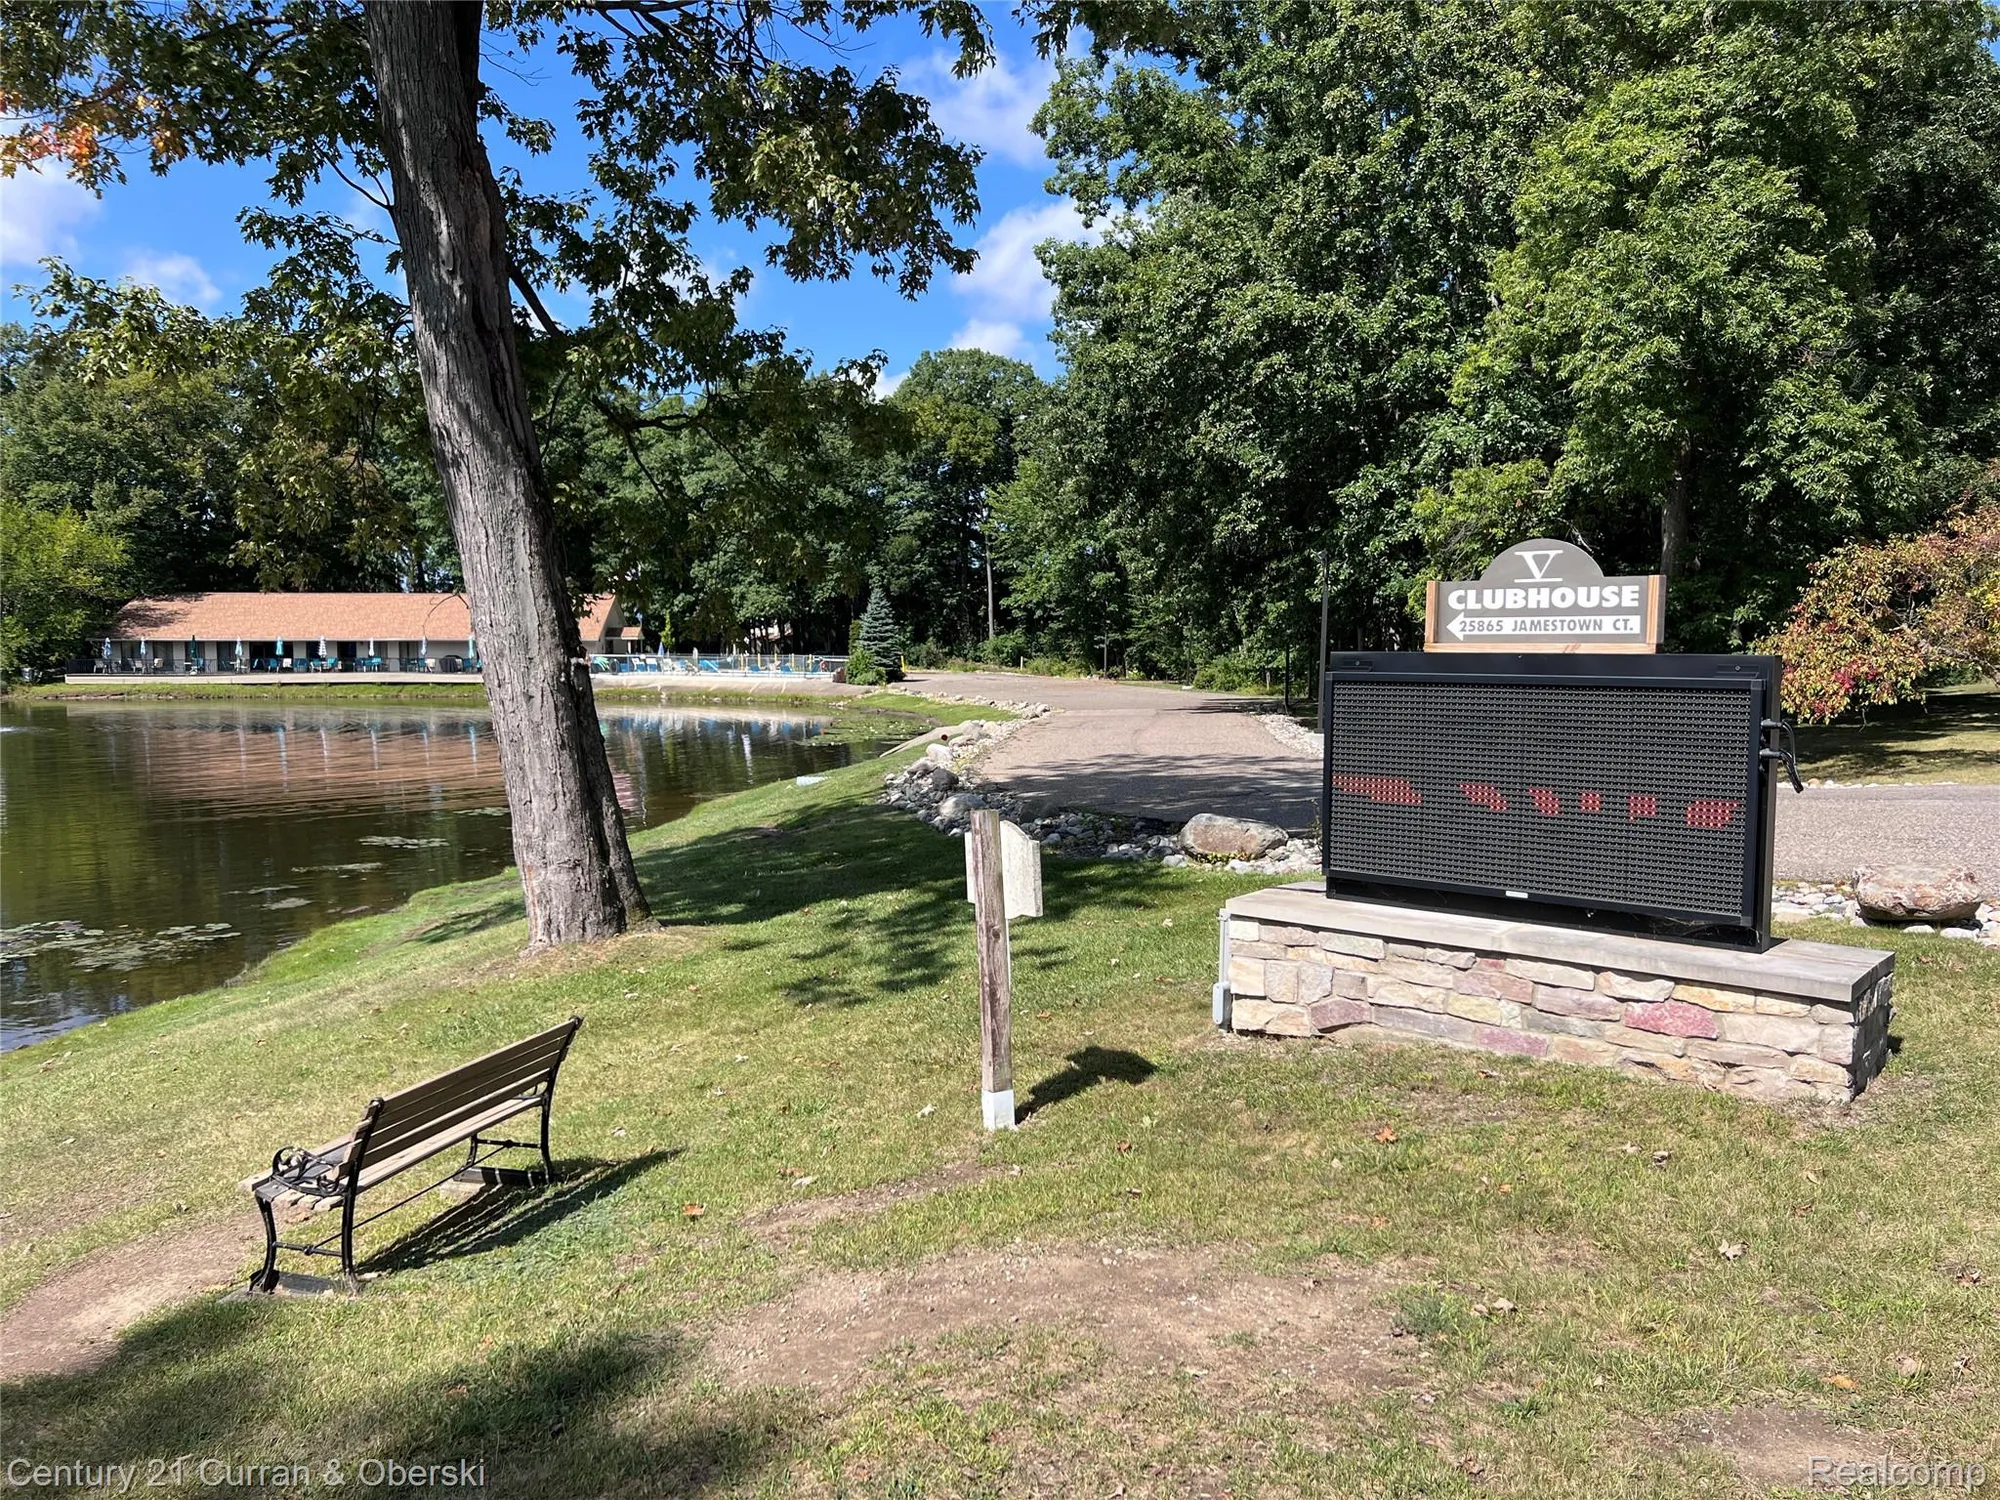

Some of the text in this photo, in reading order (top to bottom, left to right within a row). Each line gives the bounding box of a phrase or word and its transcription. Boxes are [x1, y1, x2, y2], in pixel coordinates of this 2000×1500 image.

[1448, 586, 1639, 610] CLUBHOUSE
[1459, 618, 1633, 632] 25865 JAMESTOWN CT.
